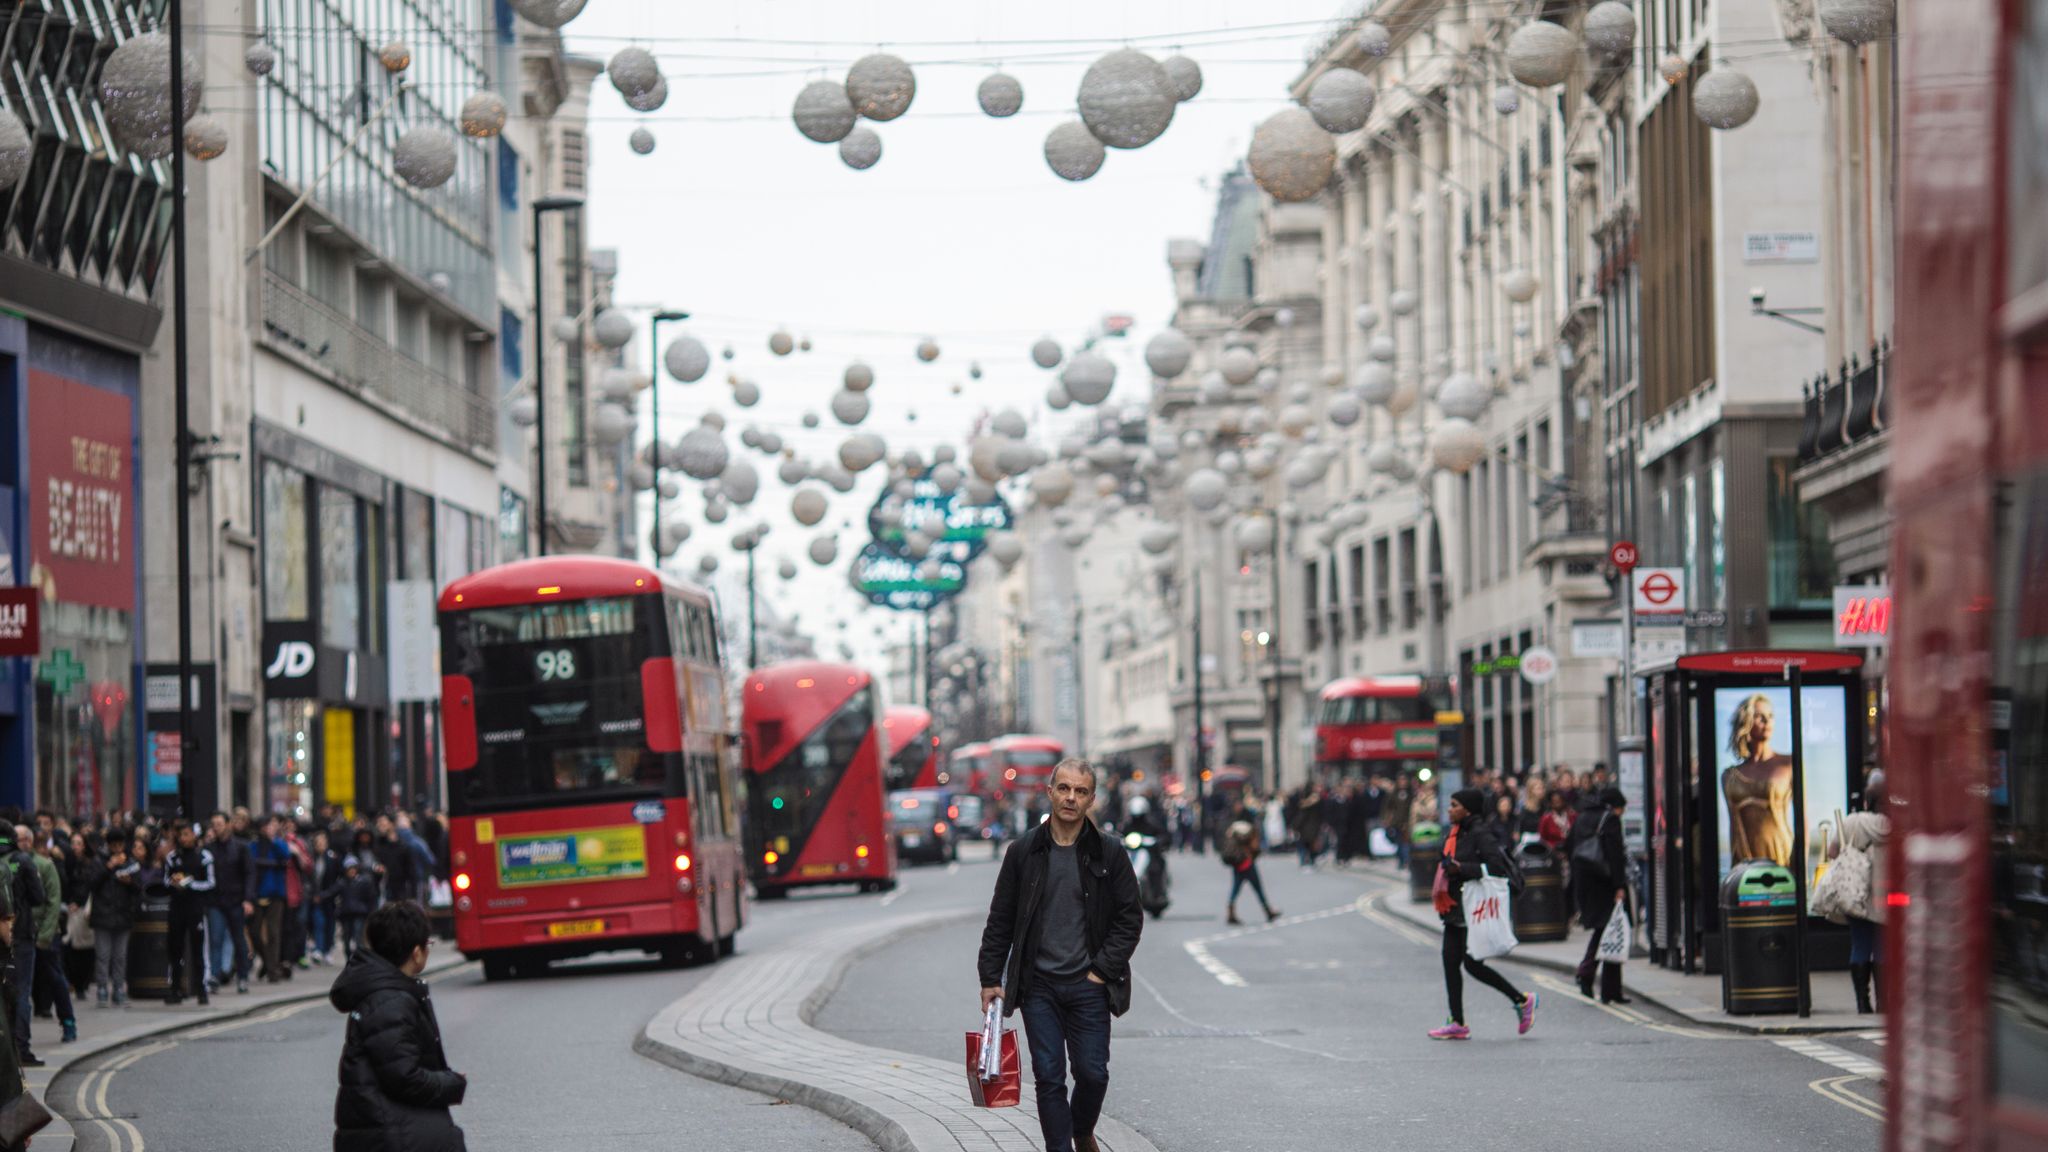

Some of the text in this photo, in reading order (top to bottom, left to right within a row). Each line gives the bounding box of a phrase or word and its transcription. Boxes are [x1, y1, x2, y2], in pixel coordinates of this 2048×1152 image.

[48, 476, 121, 562] BEAUTY
[0, 604, 27, 626] UJI
[1839, 597, 1892, 636] H&M
[266, 641, 315, 679] JD
[536, 649, 575, 681] 98
